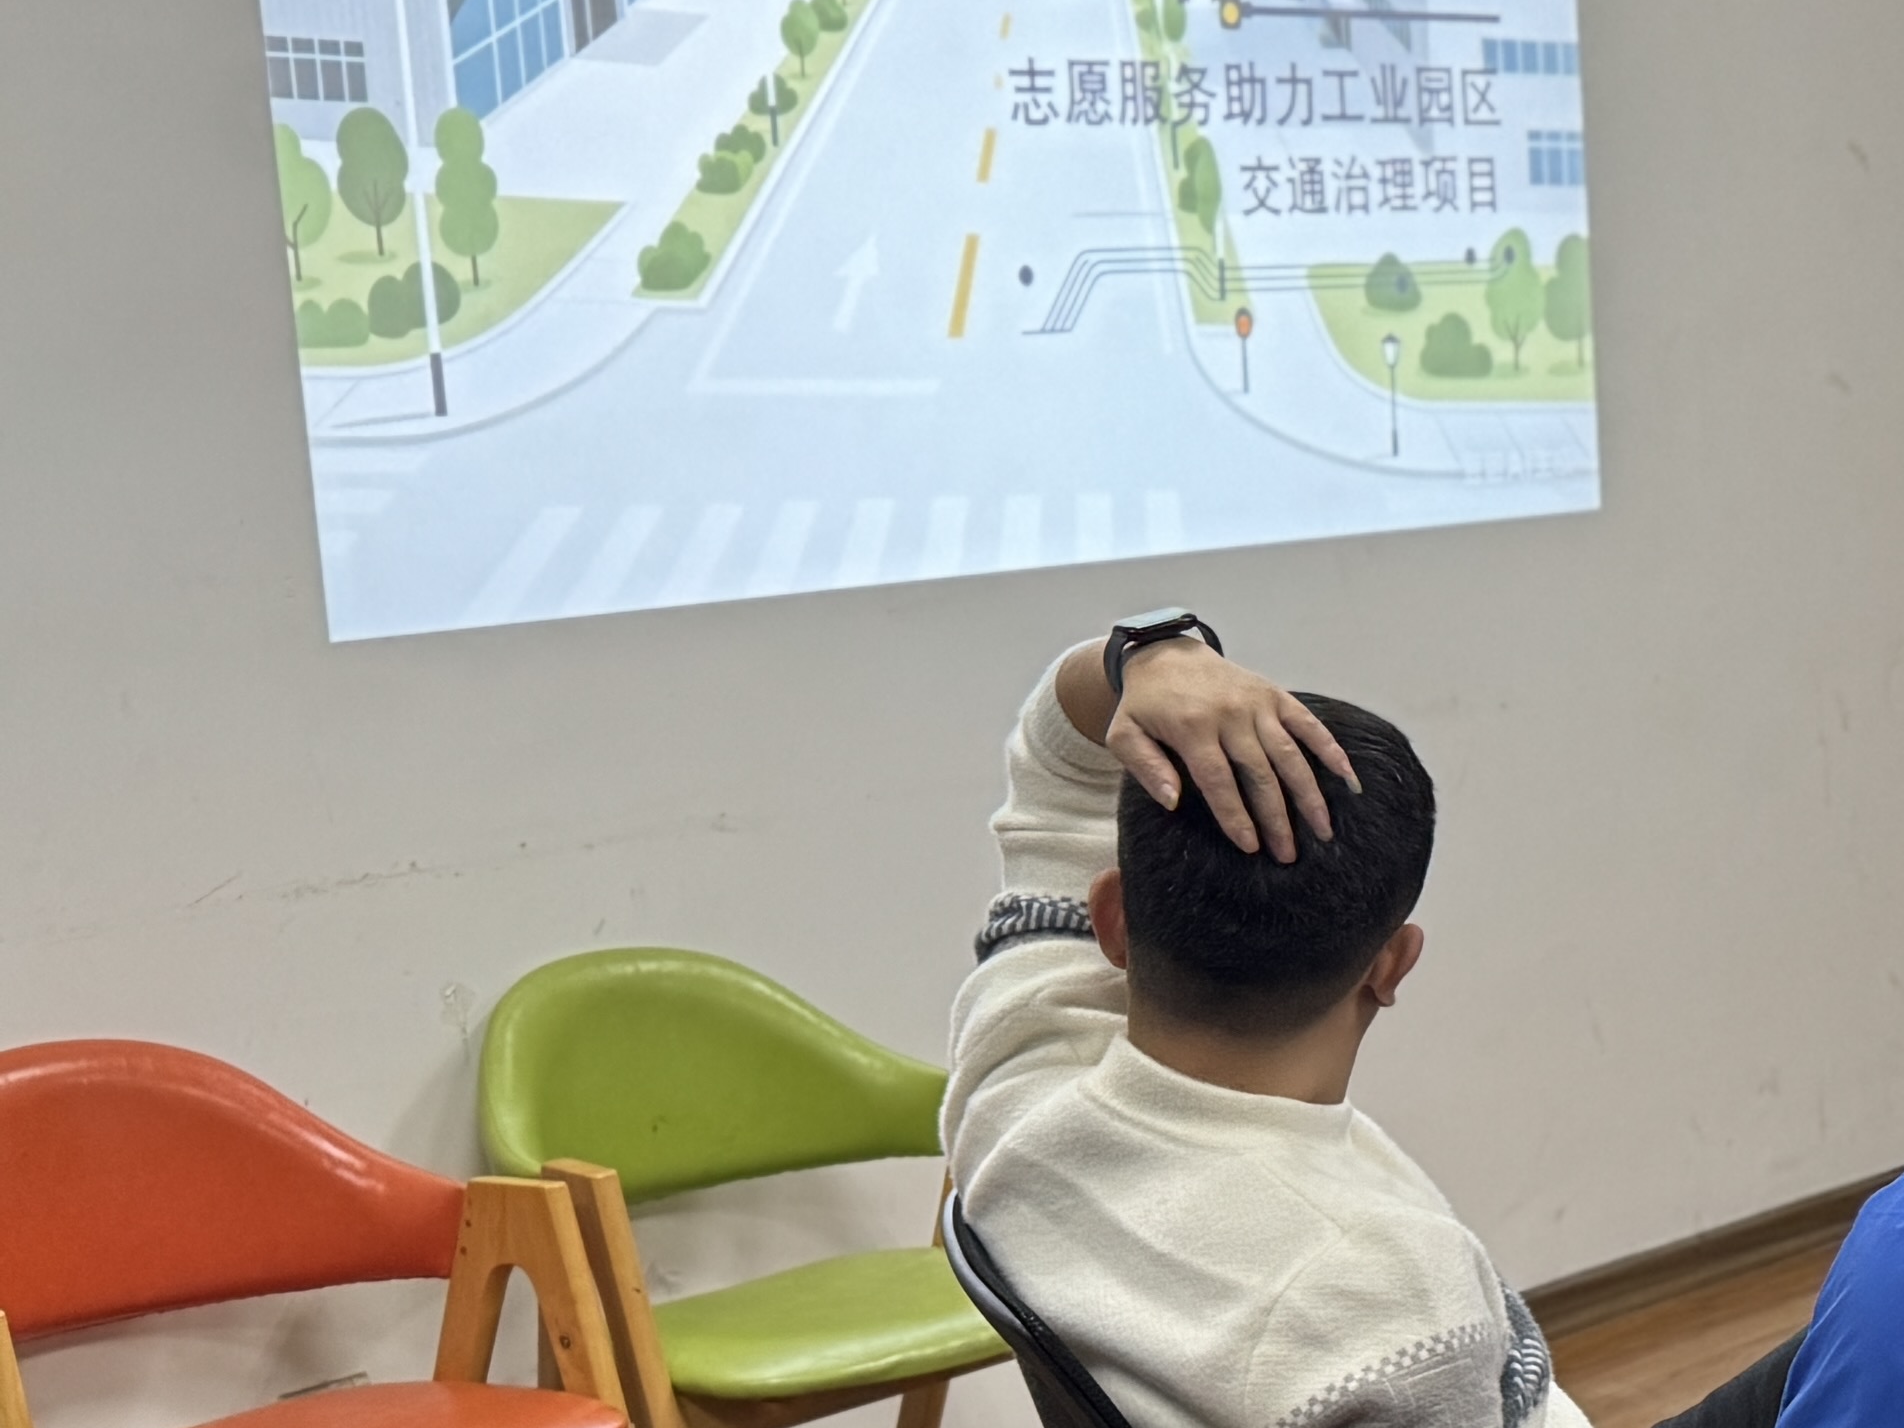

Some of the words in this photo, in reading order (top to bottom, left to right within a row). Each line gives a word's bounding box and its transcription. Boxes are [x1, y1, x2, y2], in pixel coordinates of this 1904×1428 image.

[1008, 57, 1503, 128] 志愿服务助力工业园区
[1239, 154, 1499, 217] 交通治理项目
